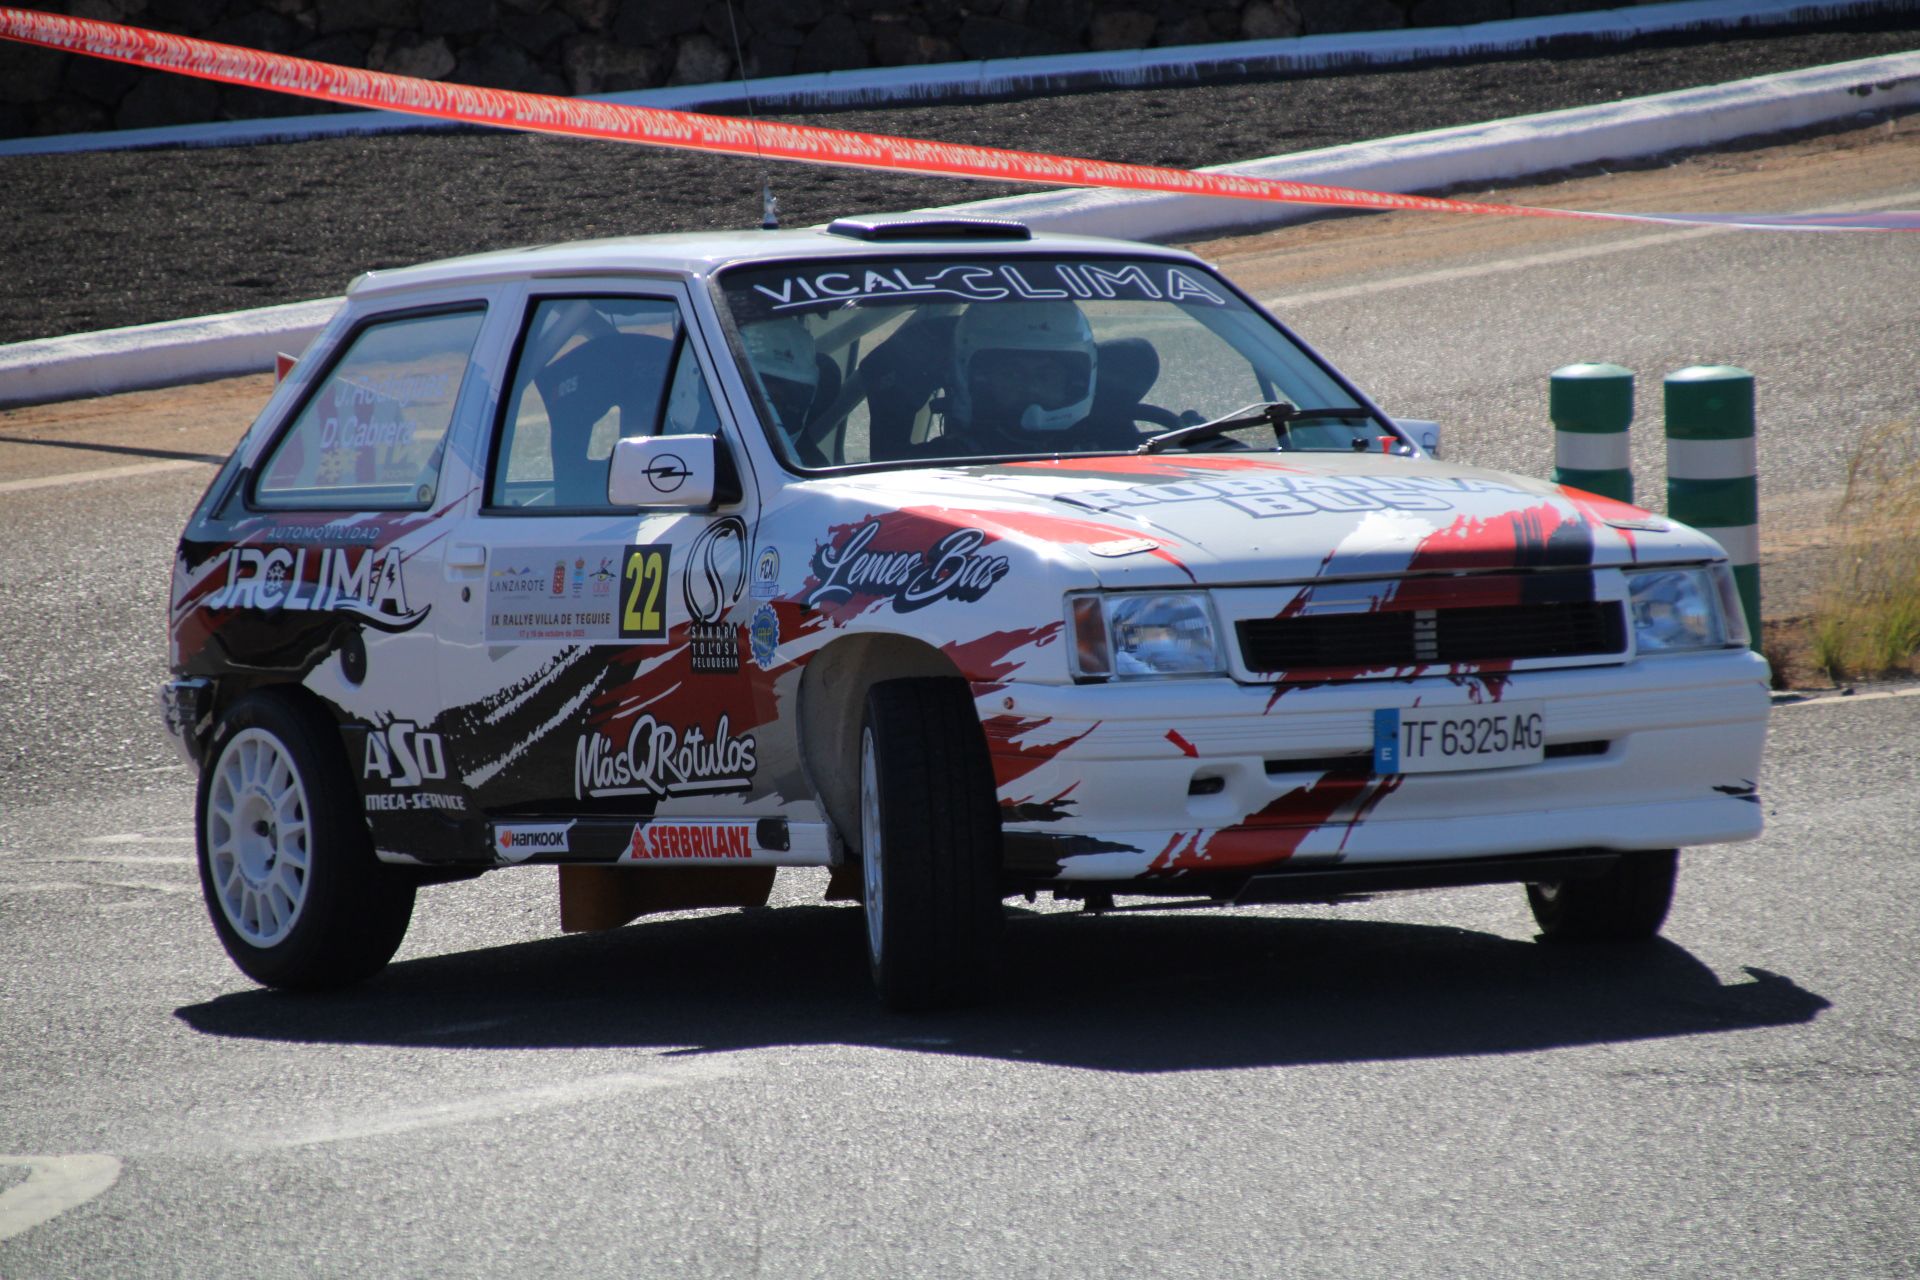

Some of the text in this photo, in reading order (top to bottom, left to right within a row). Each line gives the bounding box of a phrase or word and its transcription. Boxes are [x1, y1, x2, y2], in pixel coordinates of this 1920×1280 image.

[1218, 488, 1456, 520] BUS
[267, 526, 381, 541] AUTOMOVILIDAD
[808, 520, 1009, 604] Lemes Bus
[489, 579, 545, 593] LANZAROTE
[622, 551, 662, 632] 22
[492, 612, 611, 626] IX RALLYE VILLA DE TEGUISE
[691, 626, 738, 640] SANDRA
[692, 642, 738, 656] TOLOSA
[1381, 747, 1393, 761] E
[365, 792, 467, 811] MECA-SERVICE
[648, 825, 753, 860] SERBRILANZ
